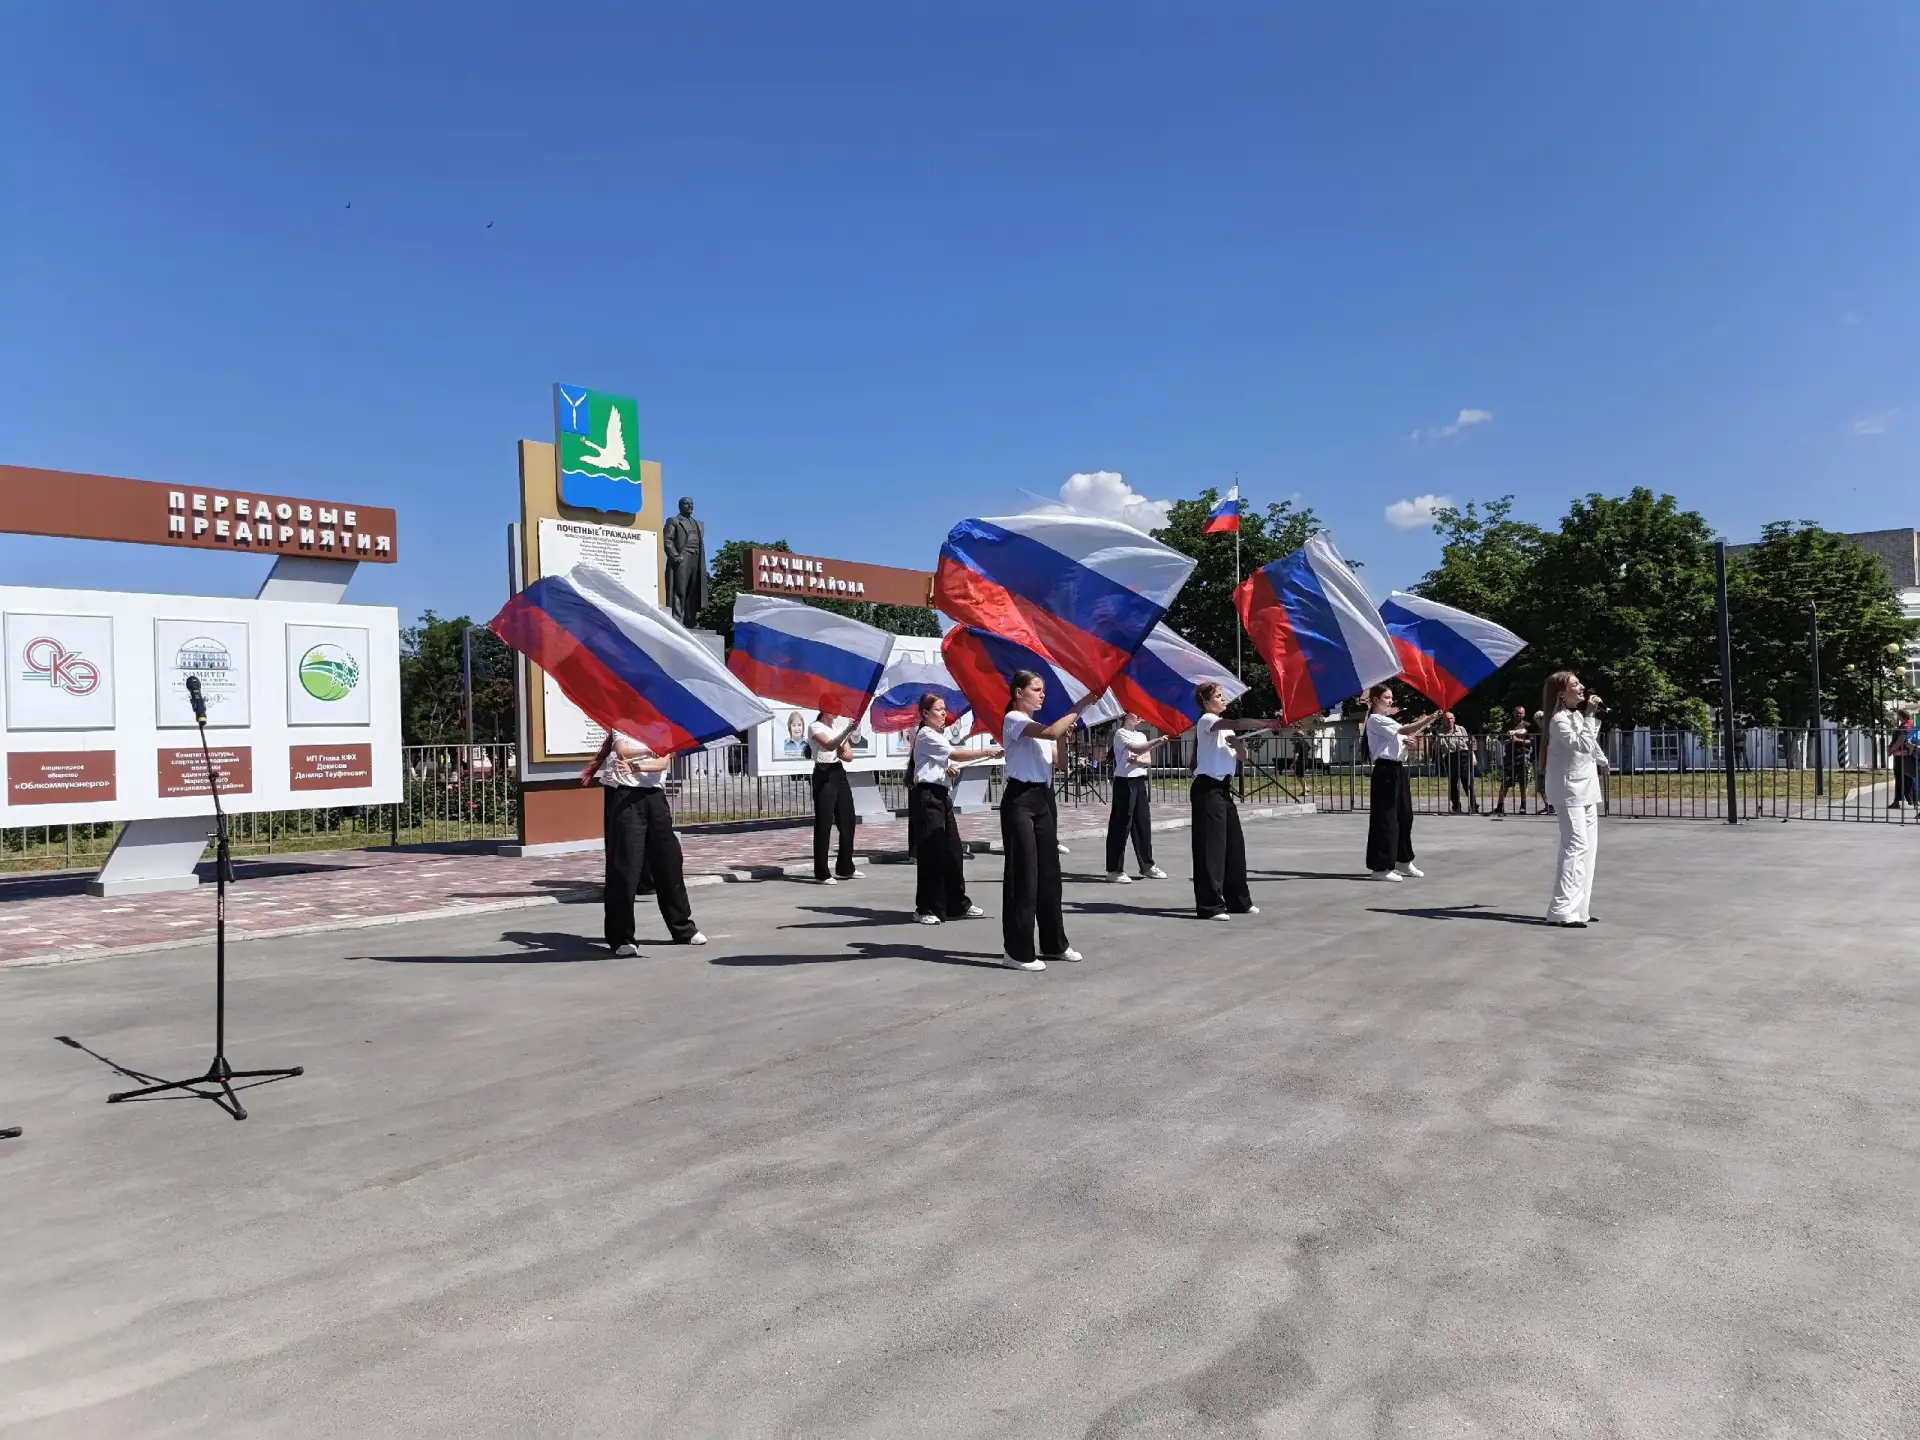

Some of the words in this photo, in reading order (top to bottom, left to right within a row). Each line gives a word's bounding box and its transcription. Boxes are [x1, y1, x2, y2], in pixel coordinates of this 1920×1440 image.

[168, 491, 357, 526] ПЕРЕДОВЫЕ
[168, 515, 391, 551] ПРЕДПРИЯТИЯ
[556, 524, 600, 536] ПОЧЕТНЫЕ
[601, 529, 642, 541] ГРАЖДАНЕ
[760, 554, 823, 573] ЛУЧШИЕ
[761, 570, 804, 587] ЛЮДИ
[809, 576, 865, 593] РАЙОНА
[15, 780, 111, 790] «Облкоммунэнерго»
